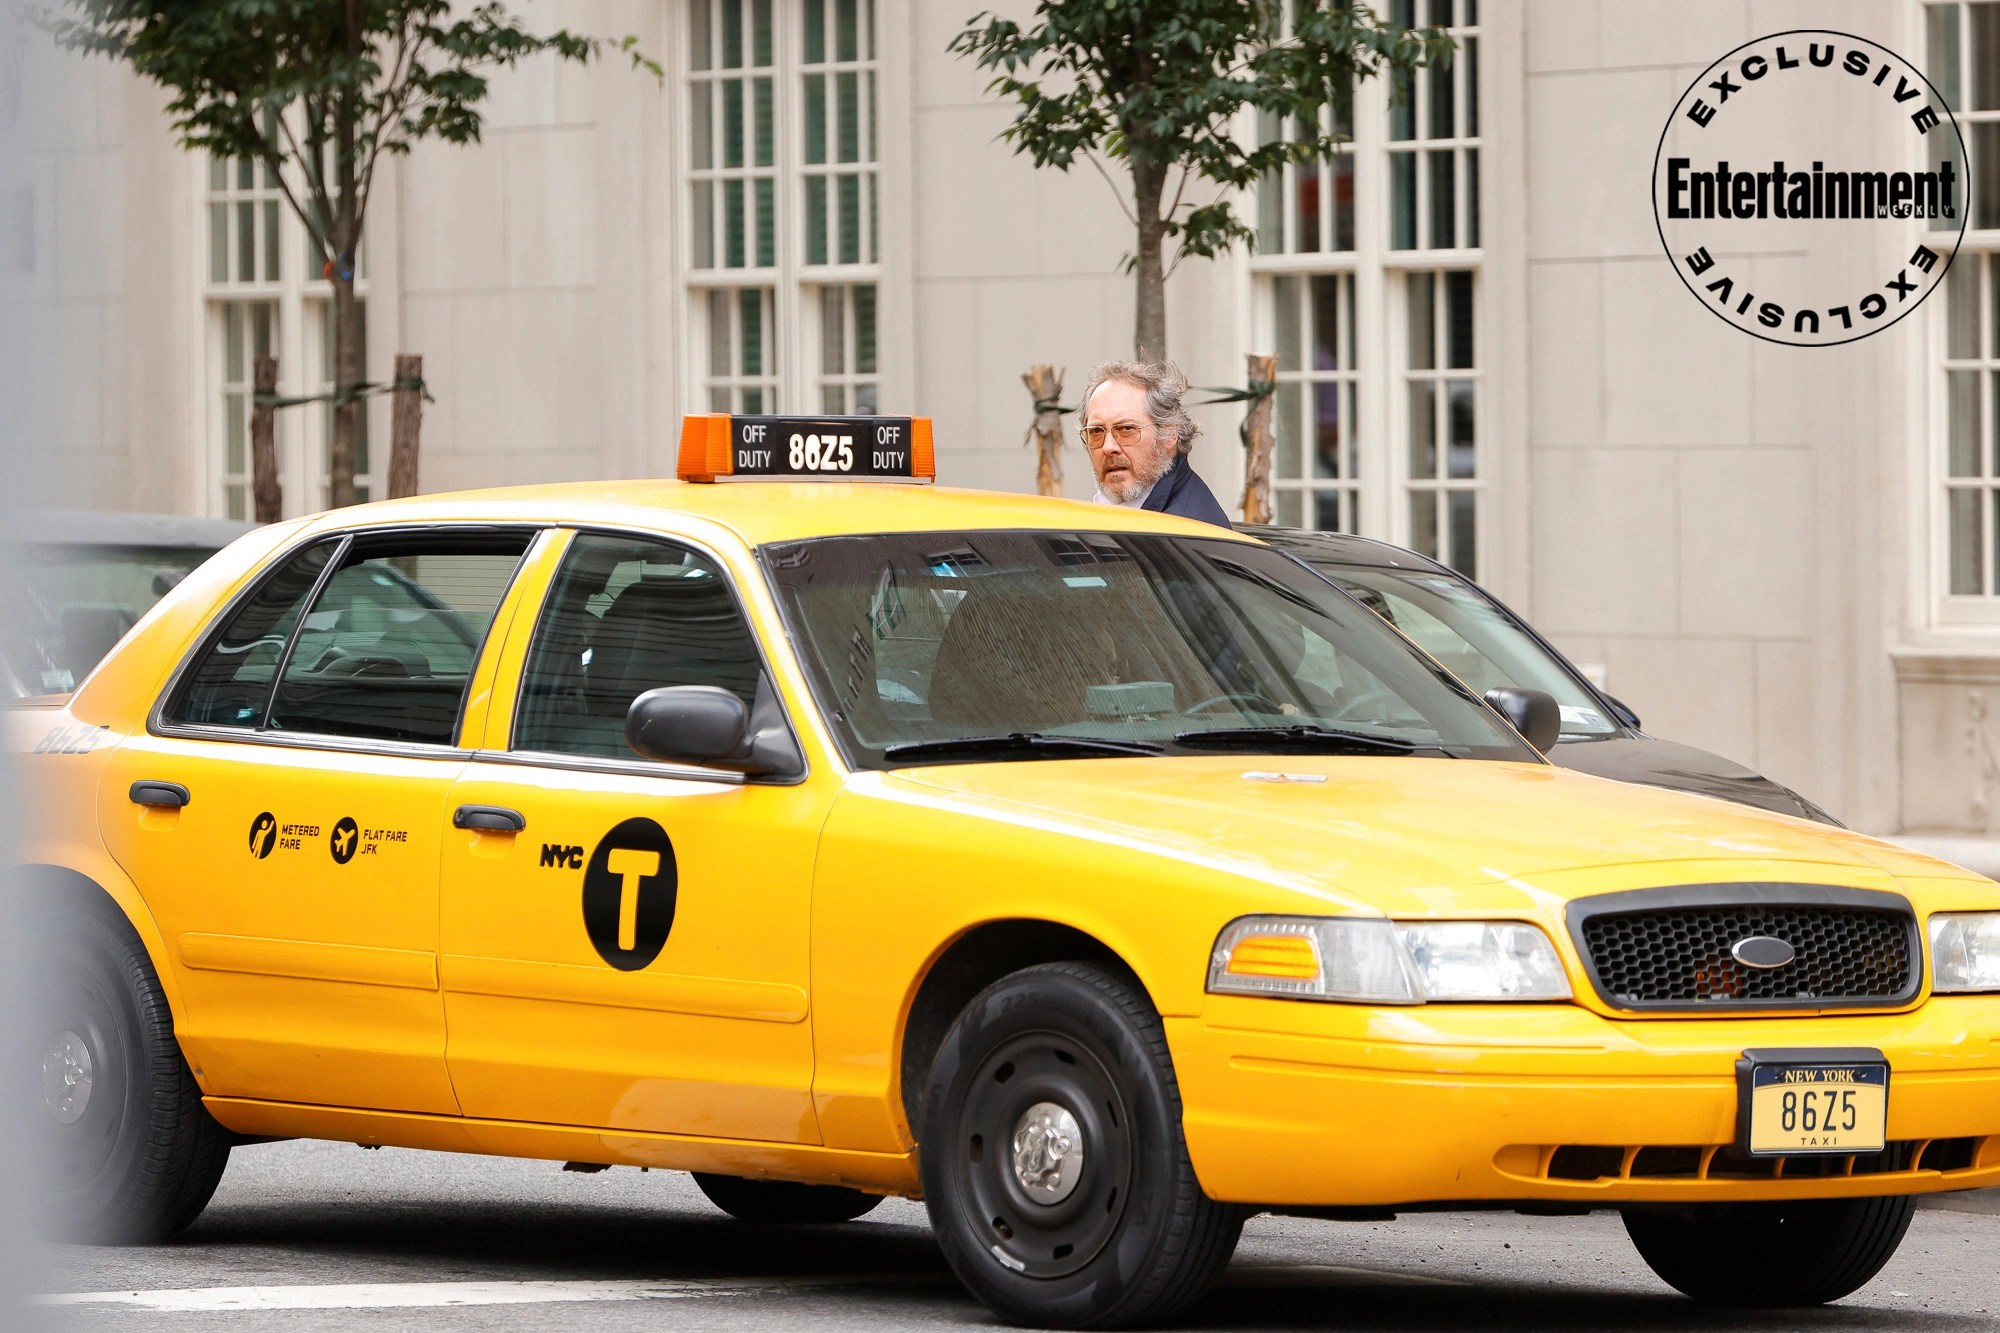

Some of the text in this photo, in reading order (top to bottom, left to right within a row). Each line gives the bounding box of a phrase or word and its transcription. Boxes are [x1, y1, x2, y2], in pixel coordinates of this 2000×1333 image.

[742, 424, 767, 444] OFF
[876, 426, 901, 445] OFF
[738, 450, 771, 469] DUTY
[872, 451, 905, 470] DUTY
[281, 823, 320, 838] METERED
[363, 829, 408, 843] FLAT FARE
[279, 838, 301, 850] FARE
[361, 843, 378, 856] JFK
[539, 843, 661, 951] NYC T
[1784, 1069, 1855, 1083] NEW YORK
[1781, 1090, 1857, 1132] 86Z5
[1800, 1137, 1838, 1146] TAXI
